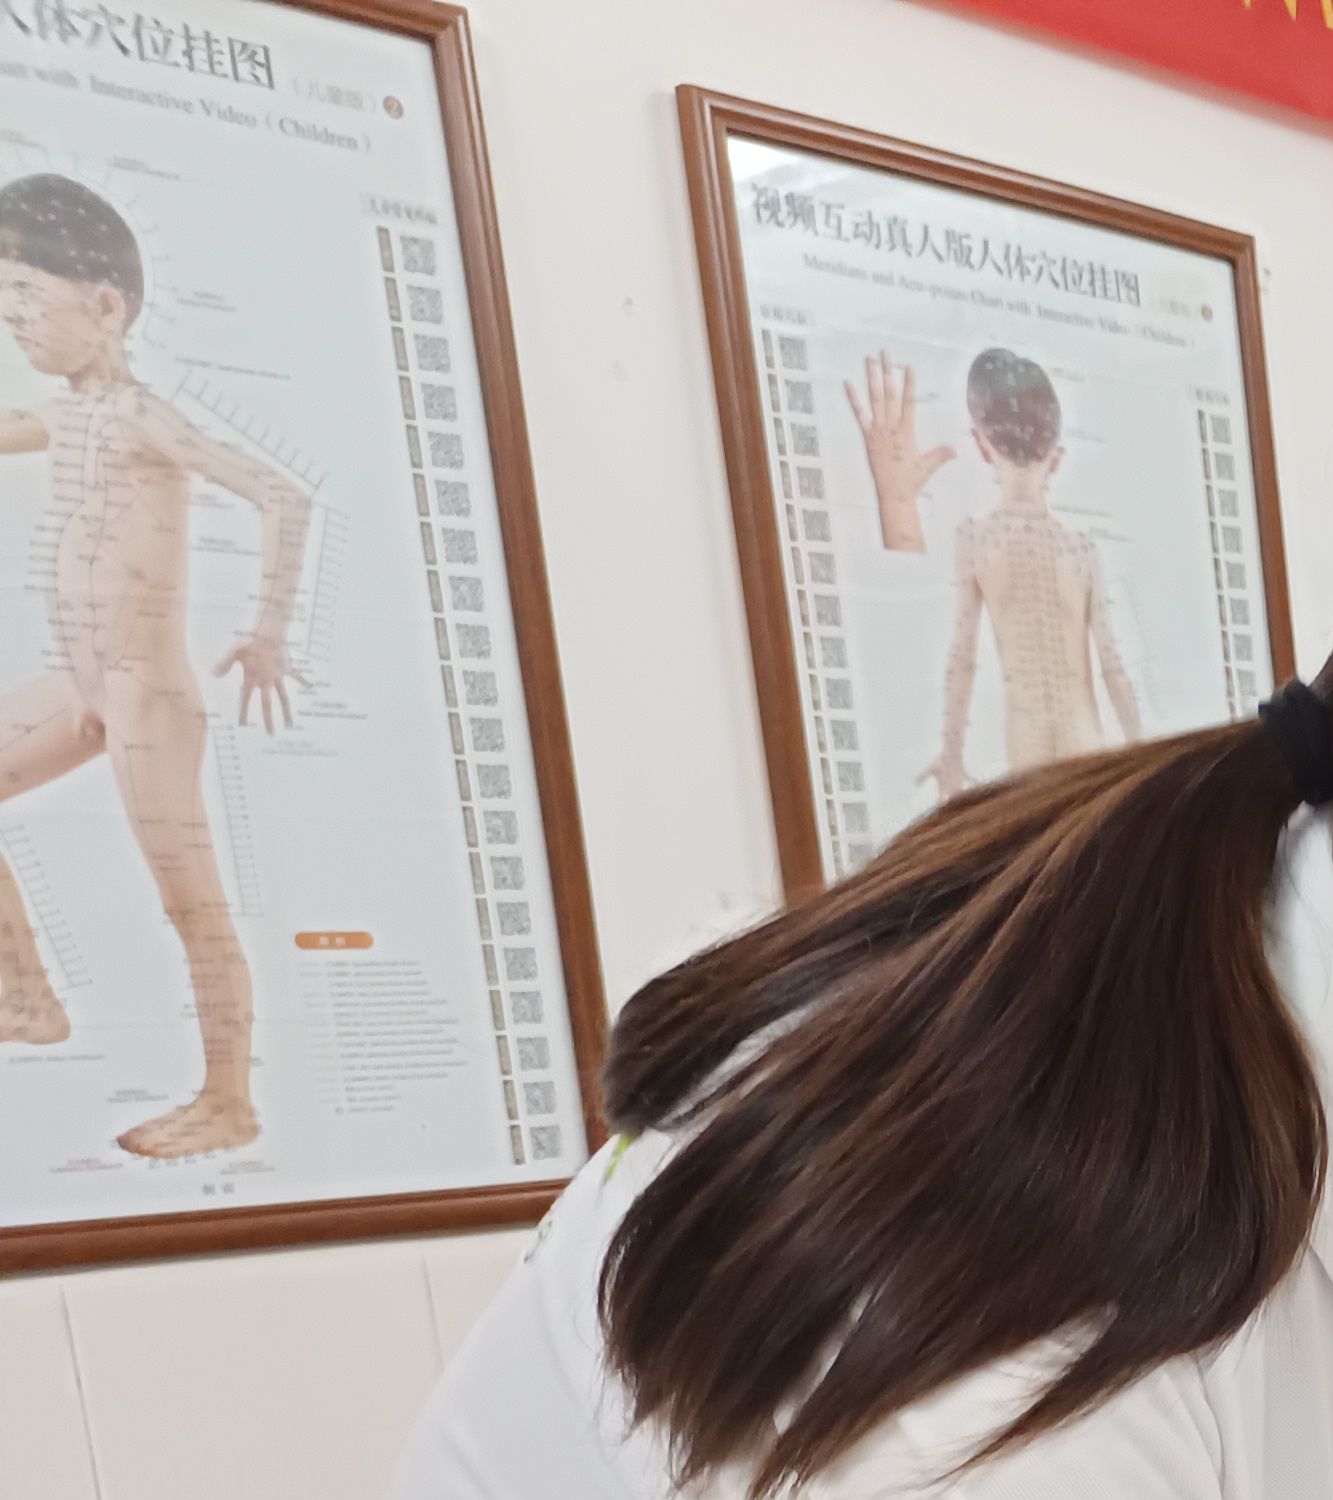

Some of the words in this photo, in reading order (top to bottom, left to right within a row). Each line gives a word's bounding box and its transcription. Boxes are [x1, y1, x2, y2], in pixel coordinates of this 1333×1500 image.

[89, 74, 195, 115] Interactive
[200, 99, 258, 129] Video
[751, 182, 1141, 308] 视频互动真人版人体穴位挂图
